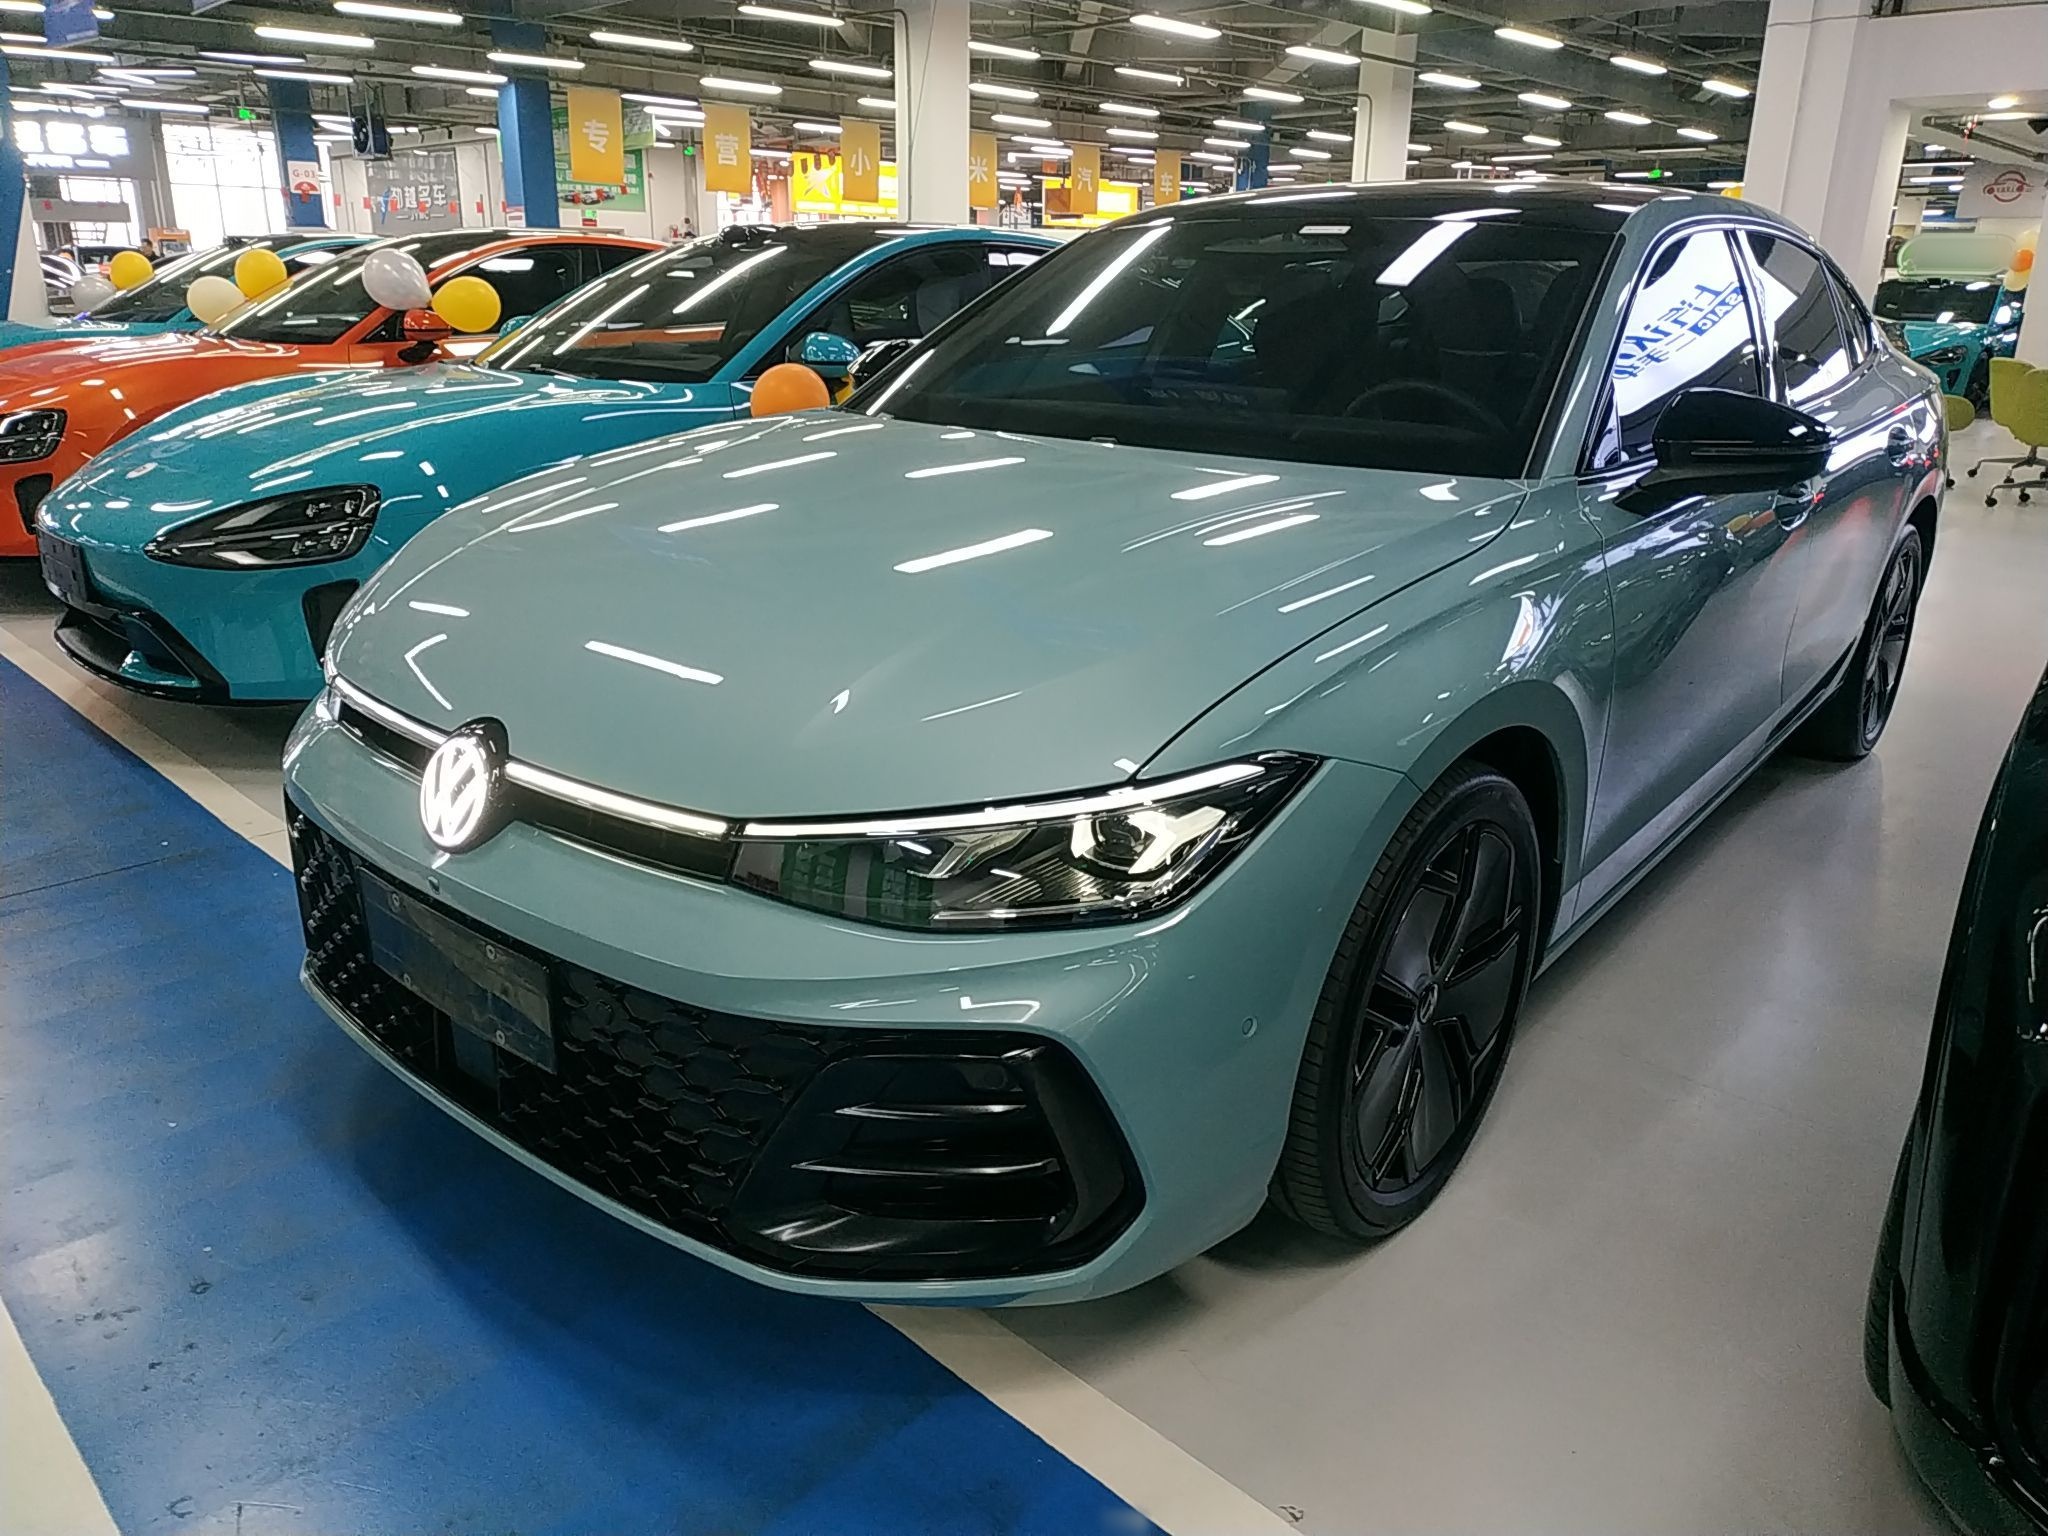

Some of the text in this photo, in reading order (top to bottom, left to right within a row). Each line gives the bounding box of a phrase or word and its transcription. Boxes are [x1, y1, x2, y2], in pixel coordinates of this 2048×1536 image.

[582, 119, 609, 154] 专
[715, 133, 739, 166] 营
[850, 147, 871, 177] 小
[969, 155, 988, 183] 米
[1077, 168, 1093, 192] 汽
[1160, 172, 1173, 196] 车
